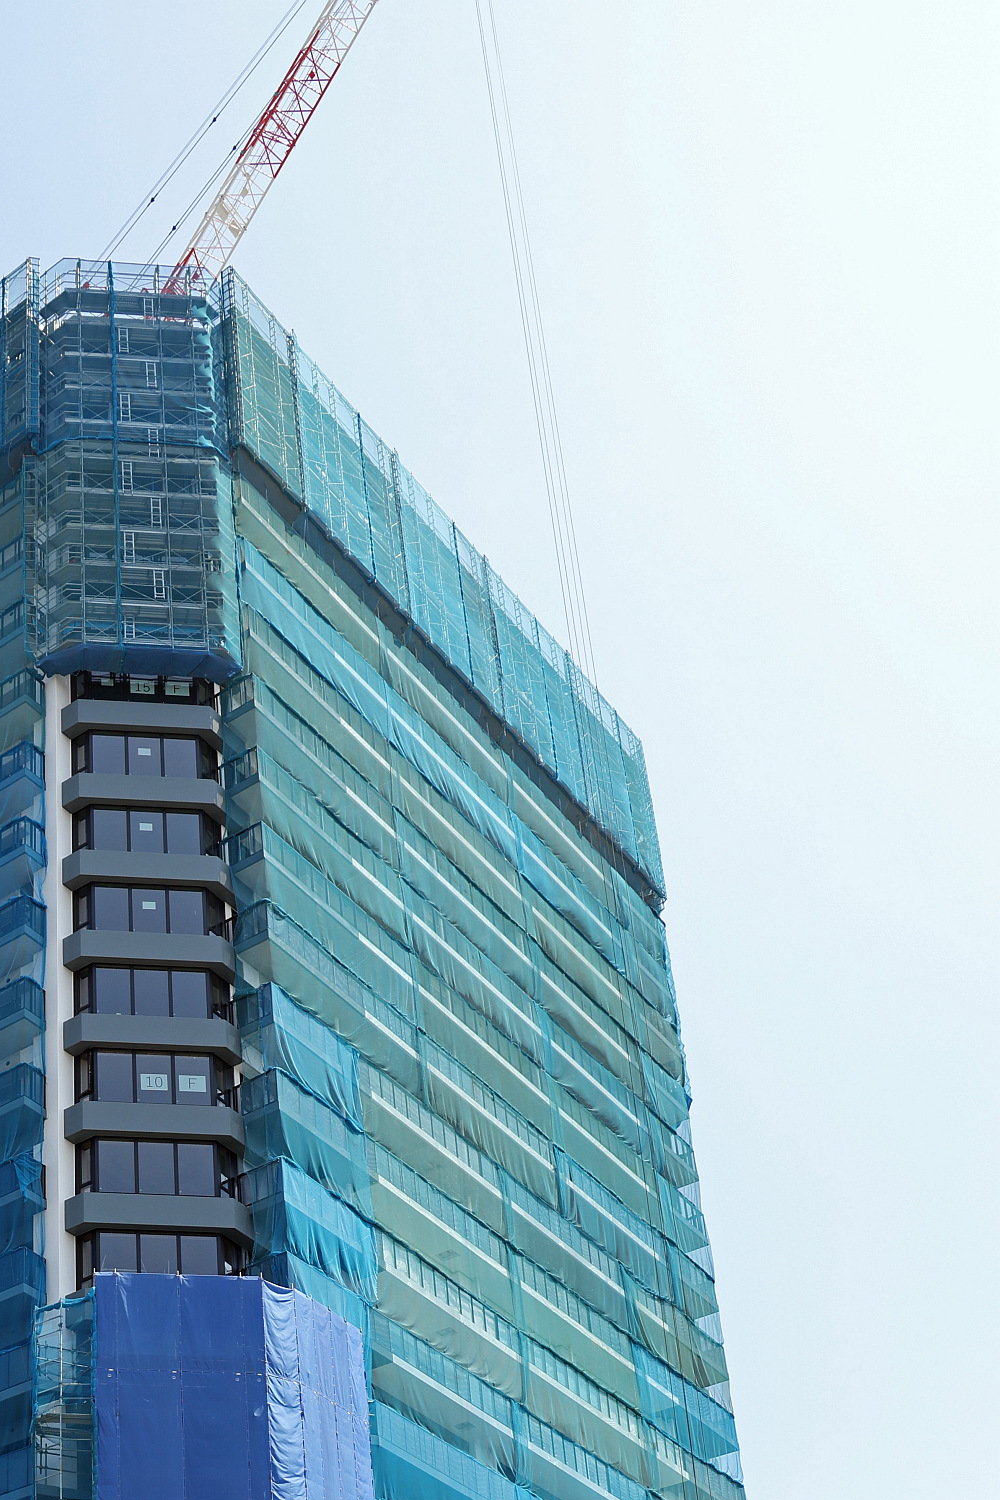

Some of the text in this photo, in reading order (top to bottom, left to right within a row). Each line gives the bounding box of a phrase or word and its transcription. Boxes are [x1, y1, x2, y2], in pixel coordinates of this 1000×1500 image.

[135, 683, 151, 693] 15
[146, 1076, 197, 1090] 10 F
